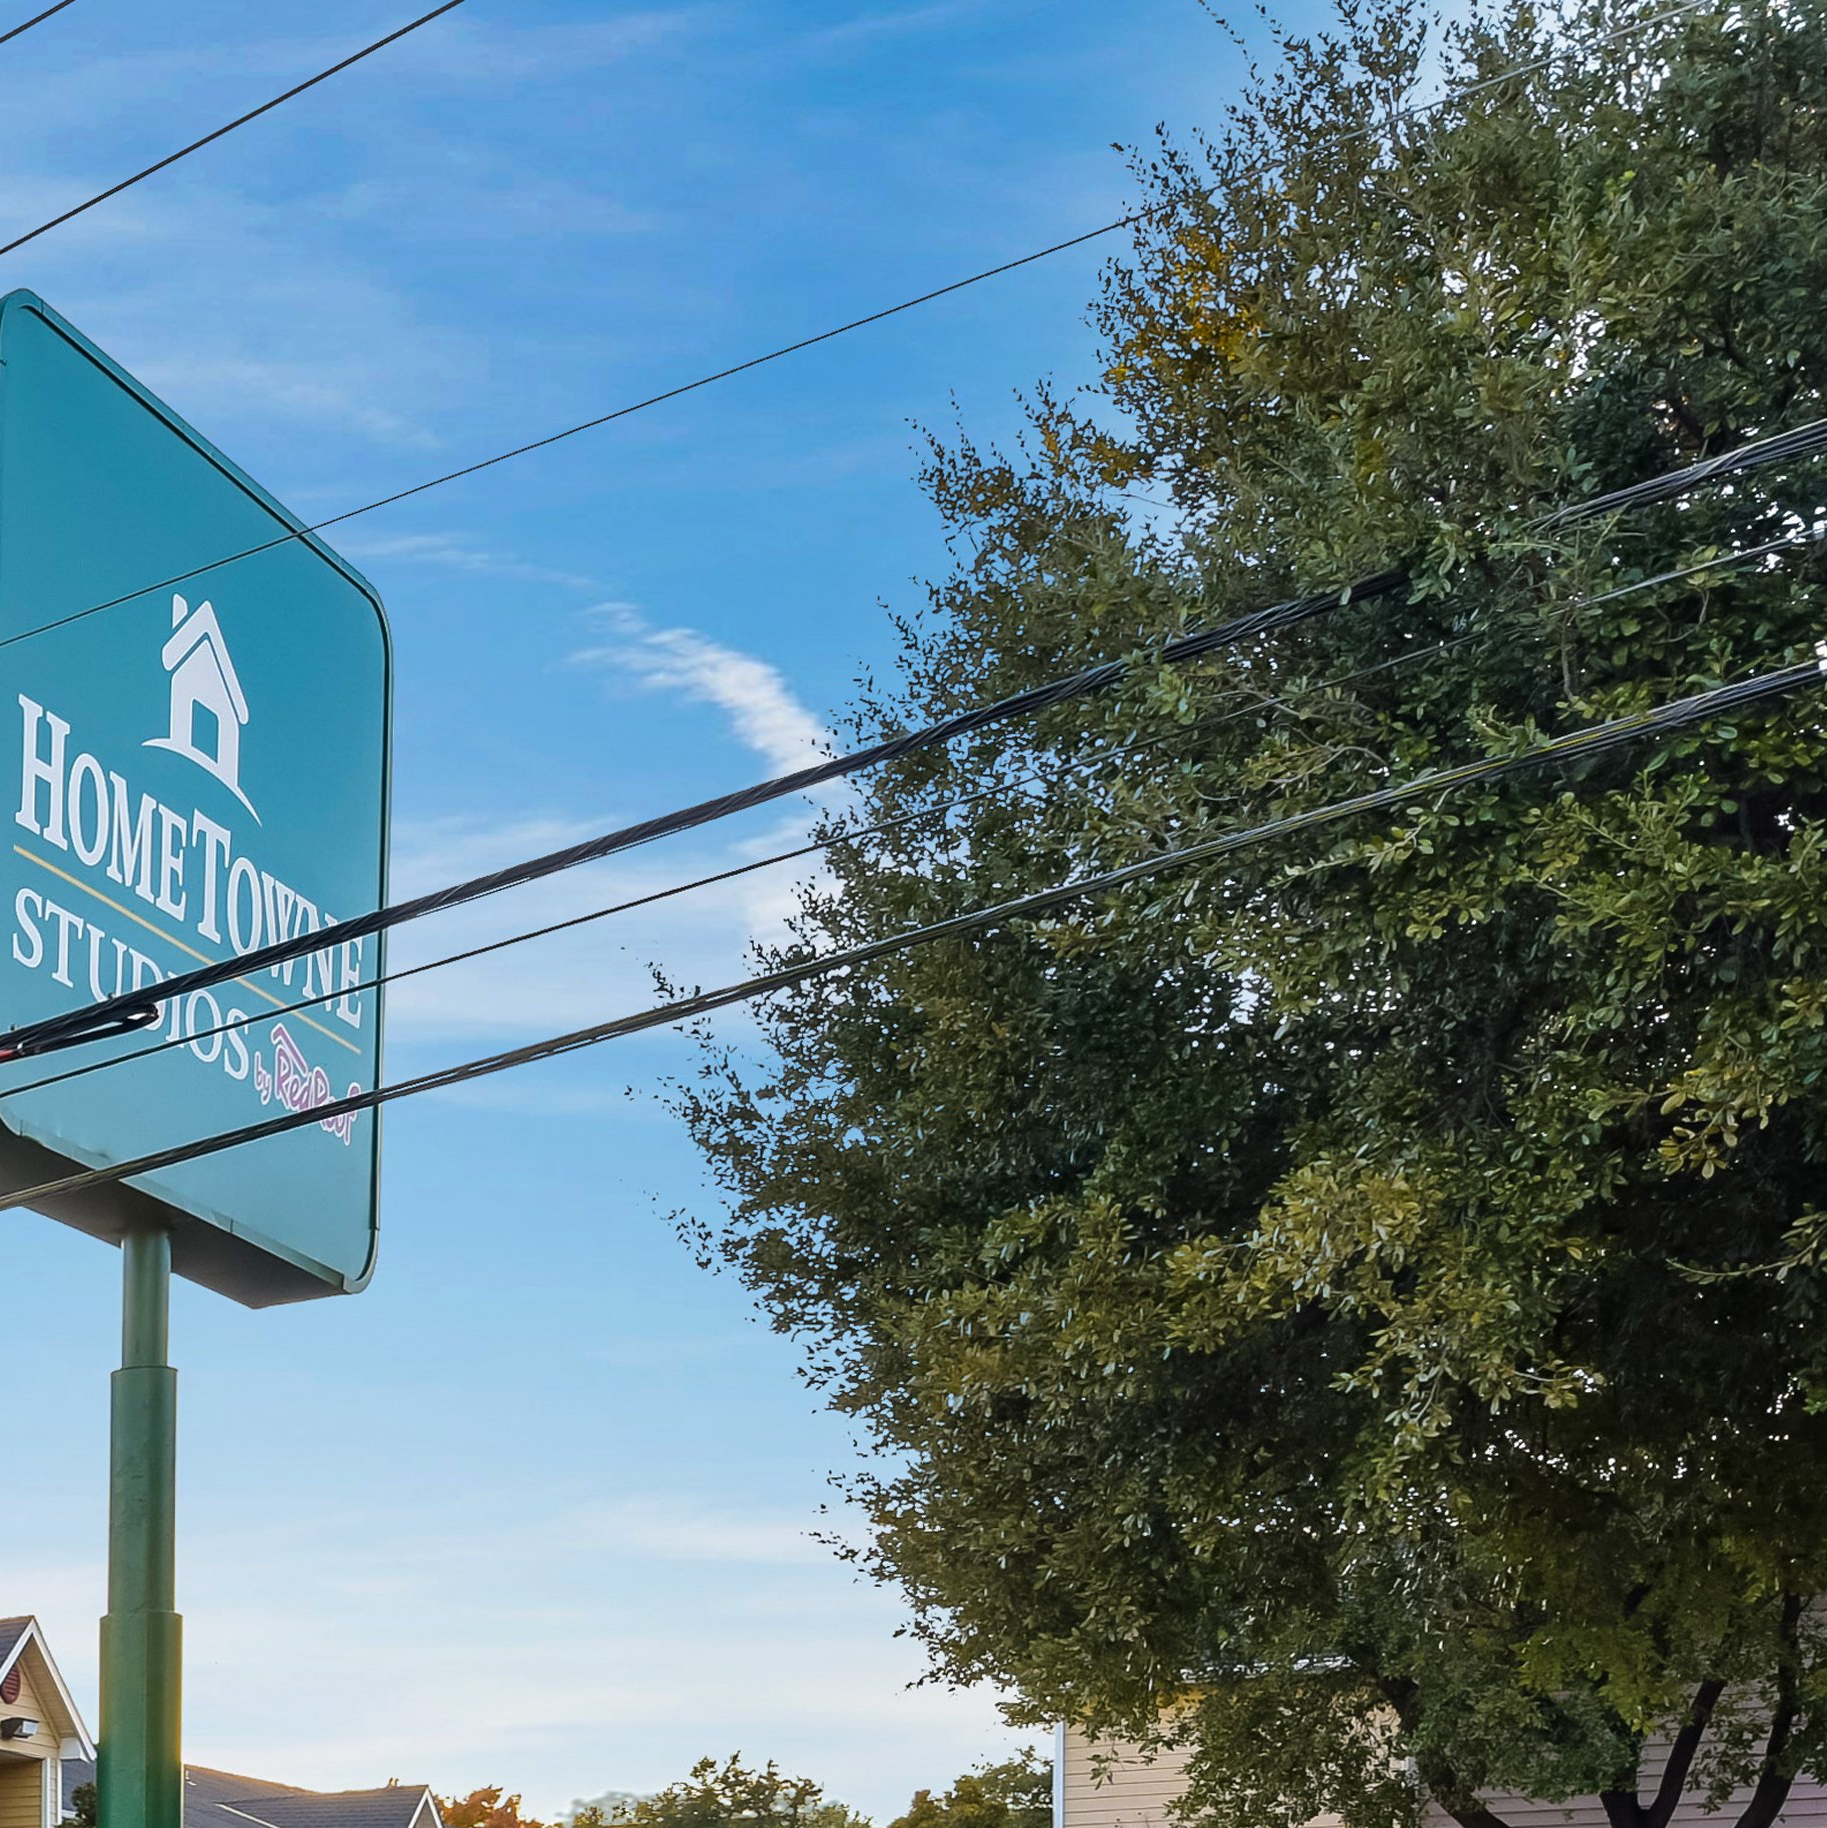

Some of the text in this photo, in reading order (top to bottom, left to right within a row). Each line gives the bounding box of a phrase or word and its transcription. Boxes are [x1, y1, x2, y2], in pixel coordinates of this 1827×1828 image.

[15, 692, 362, 1029] HOMETOWNE
[12, 887, 249, 1080] STUDIOS
[254, 1051, 272, 1105] by
